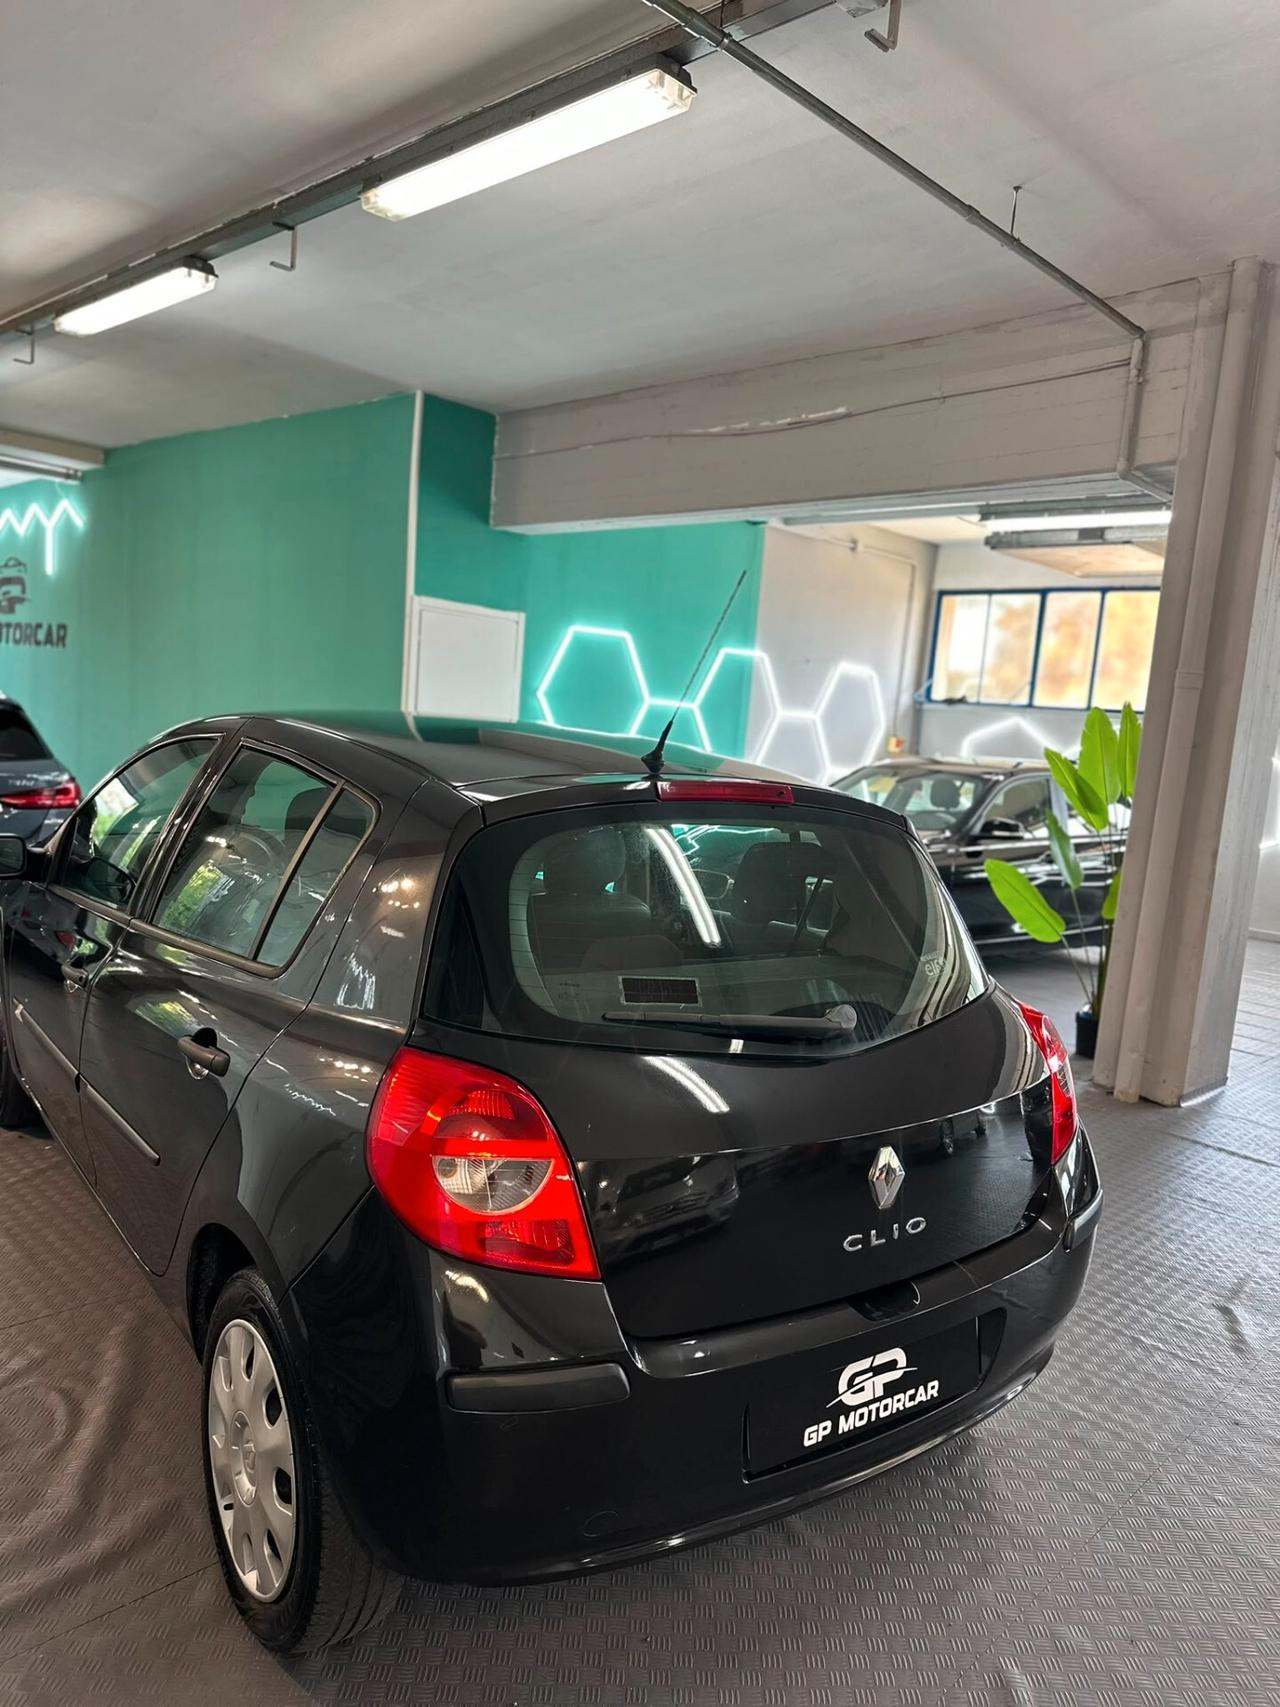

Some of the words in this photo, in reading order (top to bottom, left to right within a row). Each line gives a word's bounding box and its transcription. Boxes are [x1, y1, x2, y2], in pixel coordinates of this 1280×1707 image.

[0, 622, 68, 648] TORCAR
[843, 1217, 927, 1251] CLIO
[803, 1420, 832, 1447] GP
[838, 1380, 939, 1435] MOTORCAR
